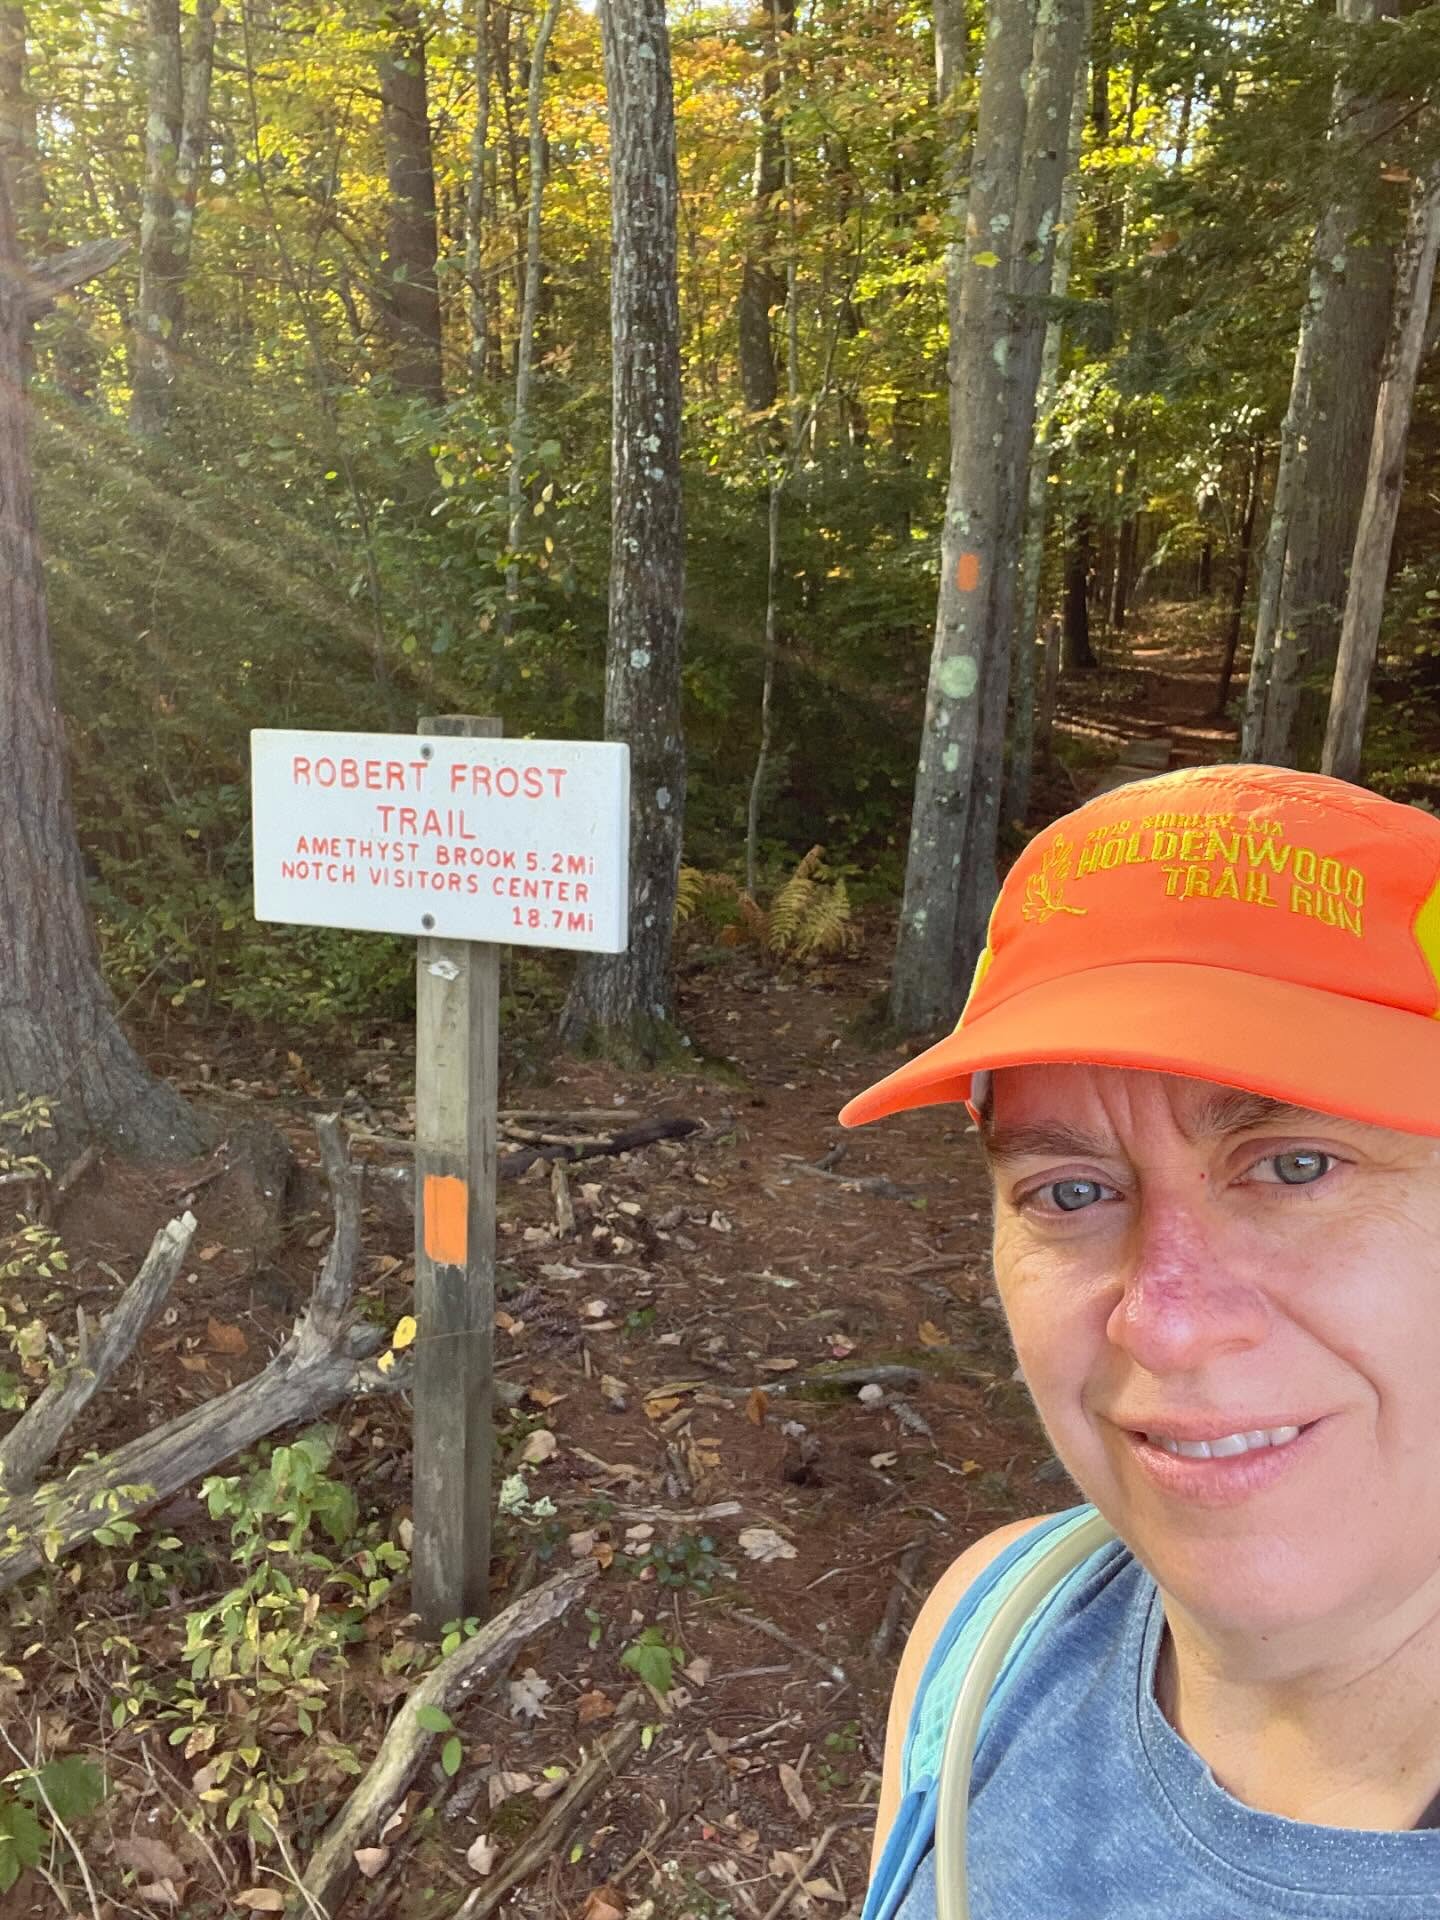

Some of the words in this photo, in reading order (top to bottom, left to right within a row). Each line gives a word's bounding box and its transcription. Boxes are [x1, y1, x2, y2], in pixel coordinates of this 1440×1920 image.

[293, 756, 428, 792] ROBERT
[449, 763, 568, 799] FROST
[376, 805, 477, 840] TRAIL
[296, 835, 419, 862] AMETHYST
[436, 844, 517, 870] BROOK
[1074, 829, 1366, 909] HOLDENWOOD
[281, 860, 356, 884] NOTCH
[369, 867, 479, 894] VISITORS
[492, 876, 589, 902] CENTER
[1161, 864, 1279, 908] TRAIL
[1289, 885, 1363, 938] RUN
[512, 906, 594, 932] 18.7Mi
